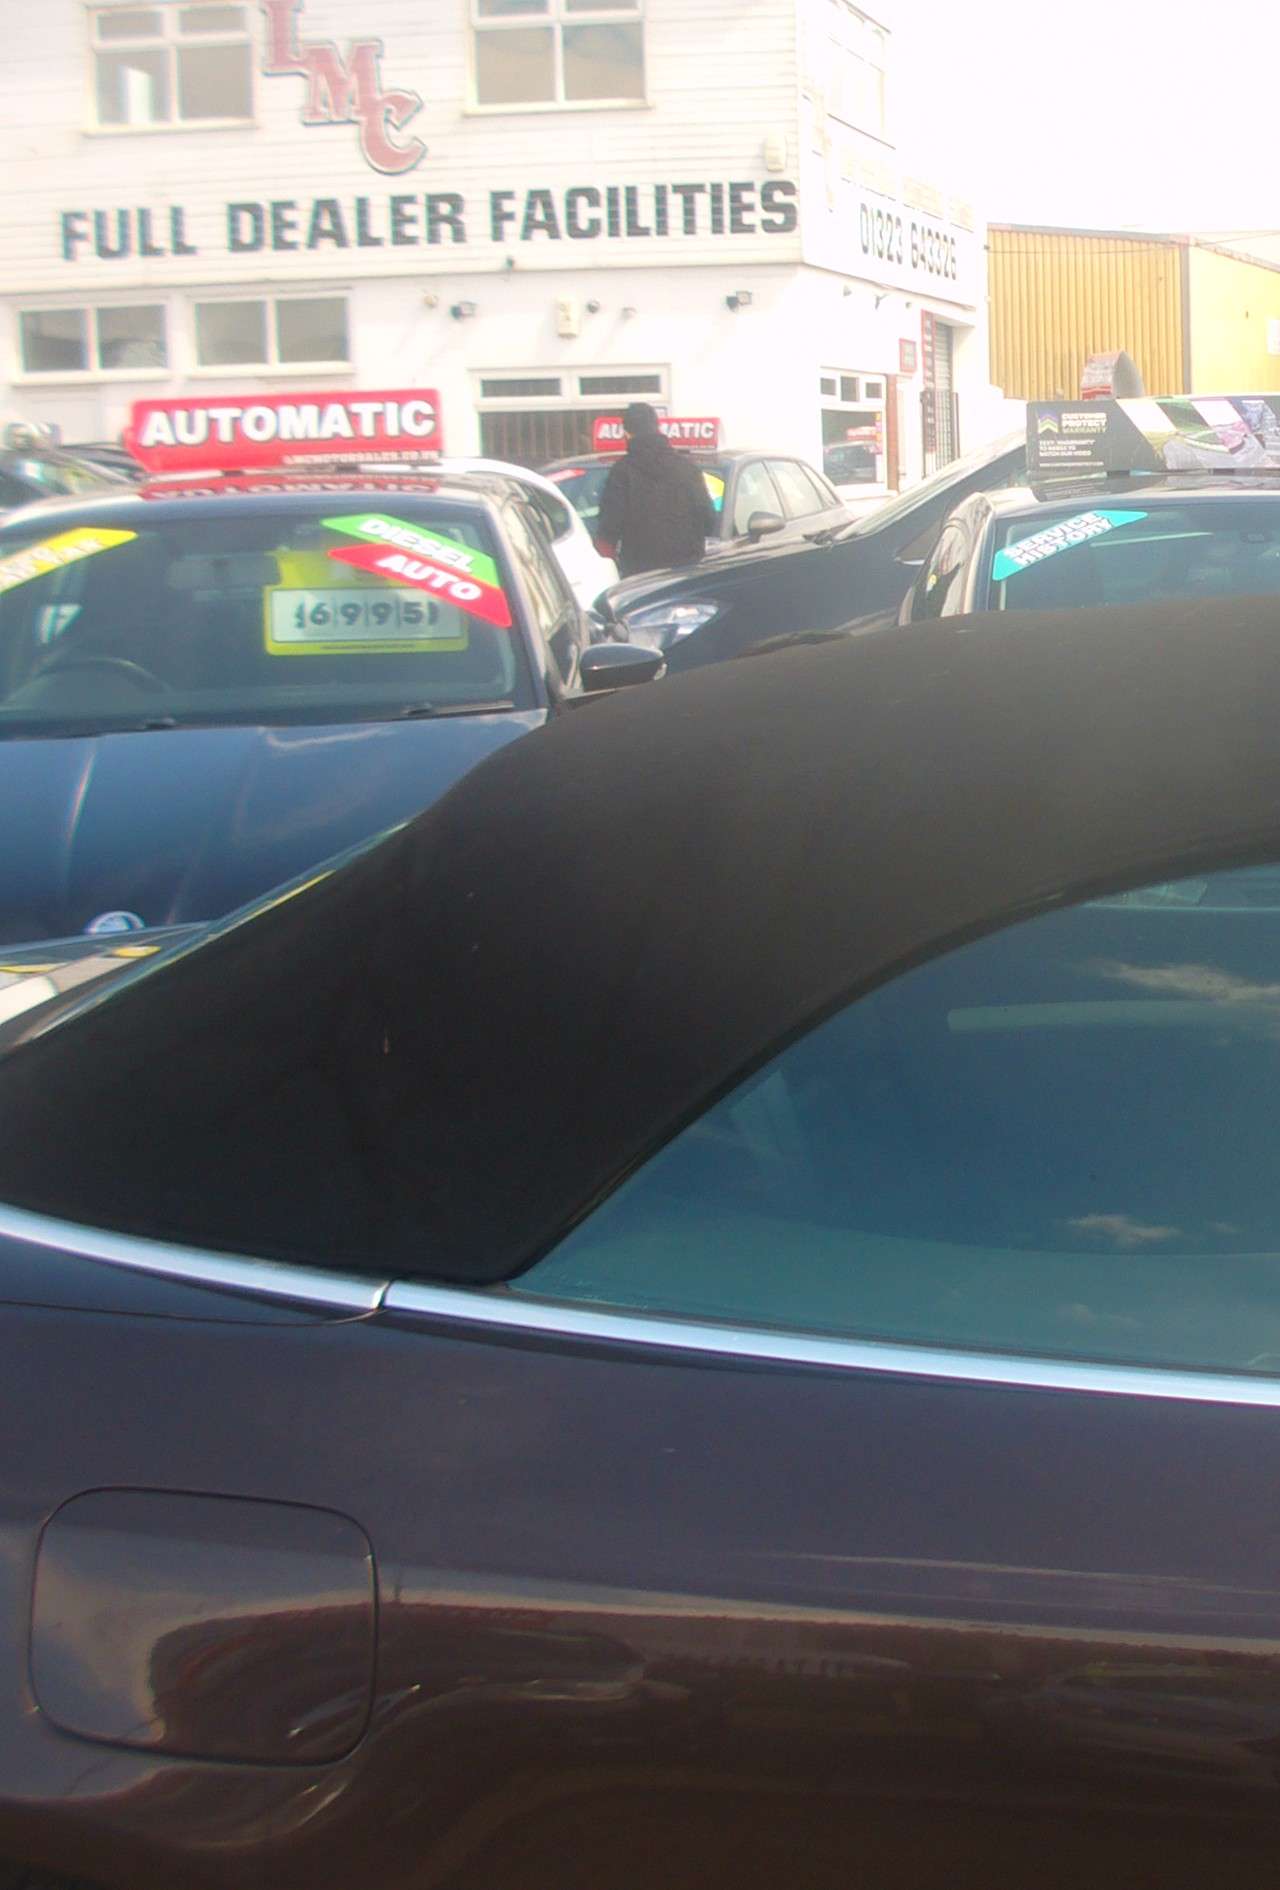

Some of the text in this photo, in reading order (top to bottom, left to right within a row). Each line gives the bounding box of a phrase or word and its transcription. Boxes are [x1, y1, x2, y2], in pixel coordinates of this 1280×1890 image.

[60, 180, 798, 260] FULL DEALER FACILITIES
[860, 203, 903, 265] 01323
[141, 400, 436, 446] AUTOMATIC
[359, 519, 476, 573] DIESEL
[1003, 511, 1105, 557] SERVICE
[1014, 518, 1113, 566] HISTORY
[376, 554, 483, 601] AUTO
